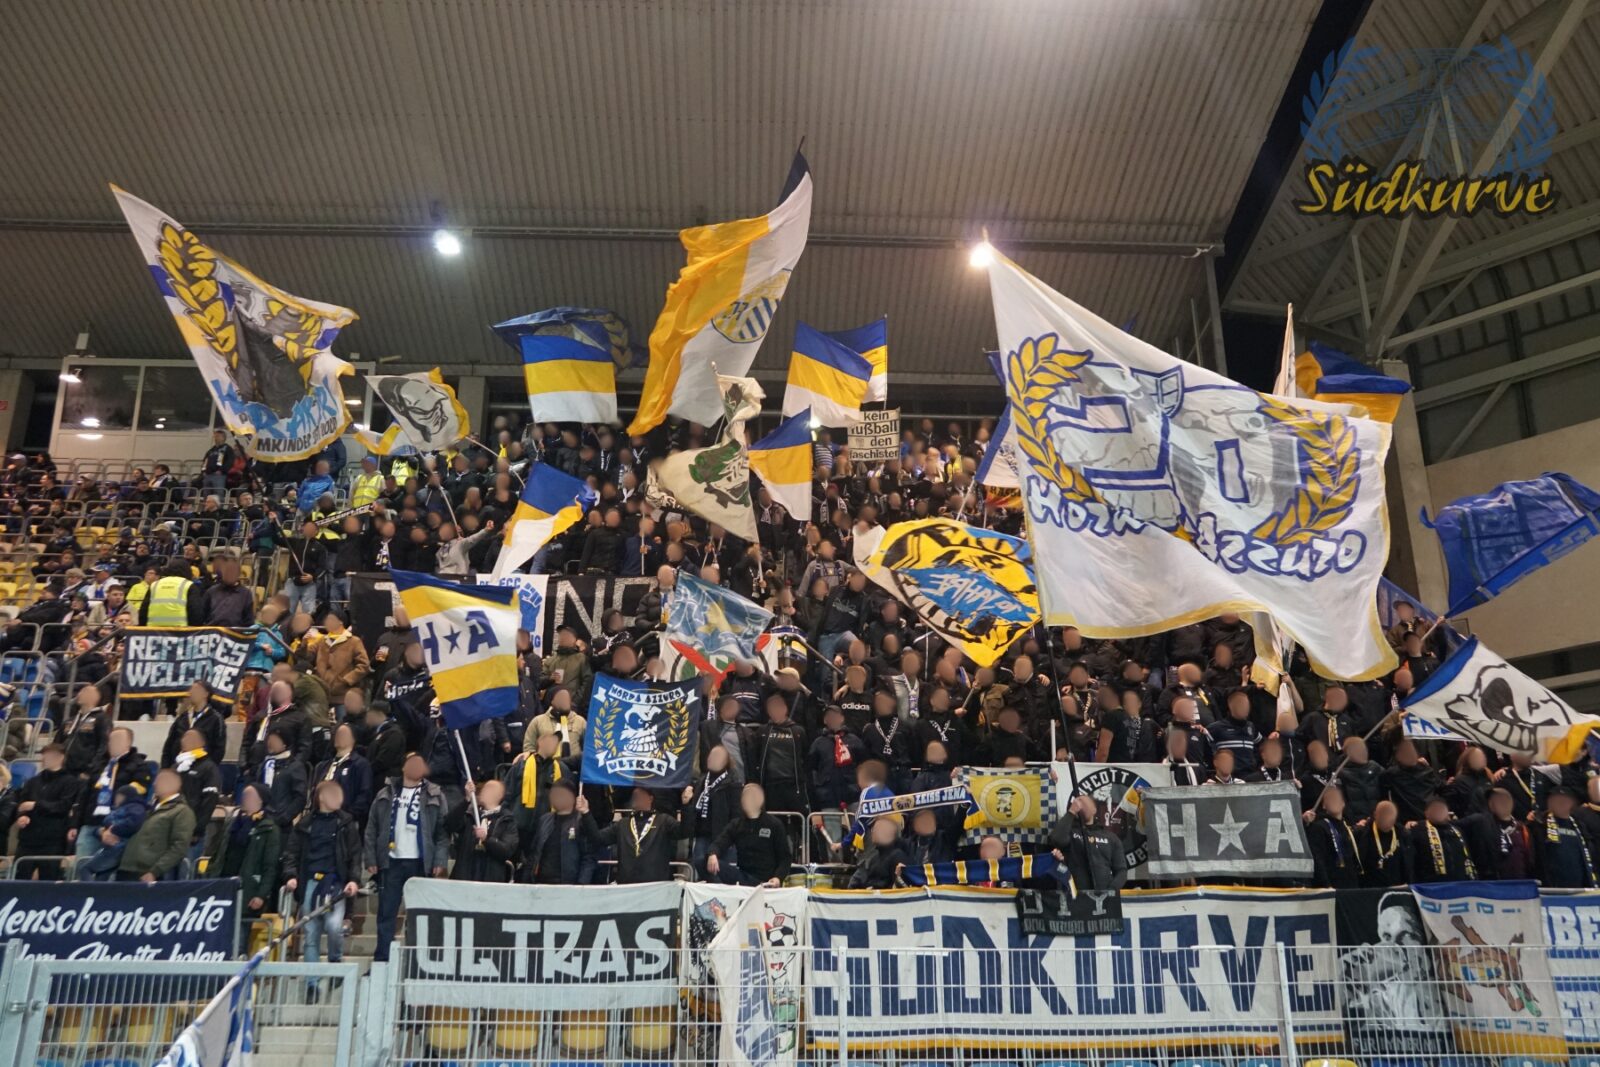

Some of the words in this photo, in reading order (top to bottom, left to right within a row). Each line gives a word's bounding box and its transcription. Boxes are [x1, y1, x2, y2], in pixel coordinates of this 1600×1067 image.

[863, 411, 889, 422] kein
[870, 436, 892, 446] den
[1193, 511, 1369, 582] Azzuro
[127, 633, 251, 668] REFUGEES
[126, 660, 240, 694] WELCOME
[644, 688, 682, 704] AZZURO
[840, 702, 871, 712] adidas
[608, 758, 666, 775] ULTRAS
[869, 798, 892, 812] CARL
[915, 789, 940, 806] ZEISS
[941, 786, 966, 801] JENA
[1073, 769, 1130, 799] YCOTT
[1153, 802, 1200, 857] H
[1264, 799, 1306, 854] A
[415, 914, 672, 980] ULTRAS
[811, 912, 1336, 1018] SÜDKURVE
